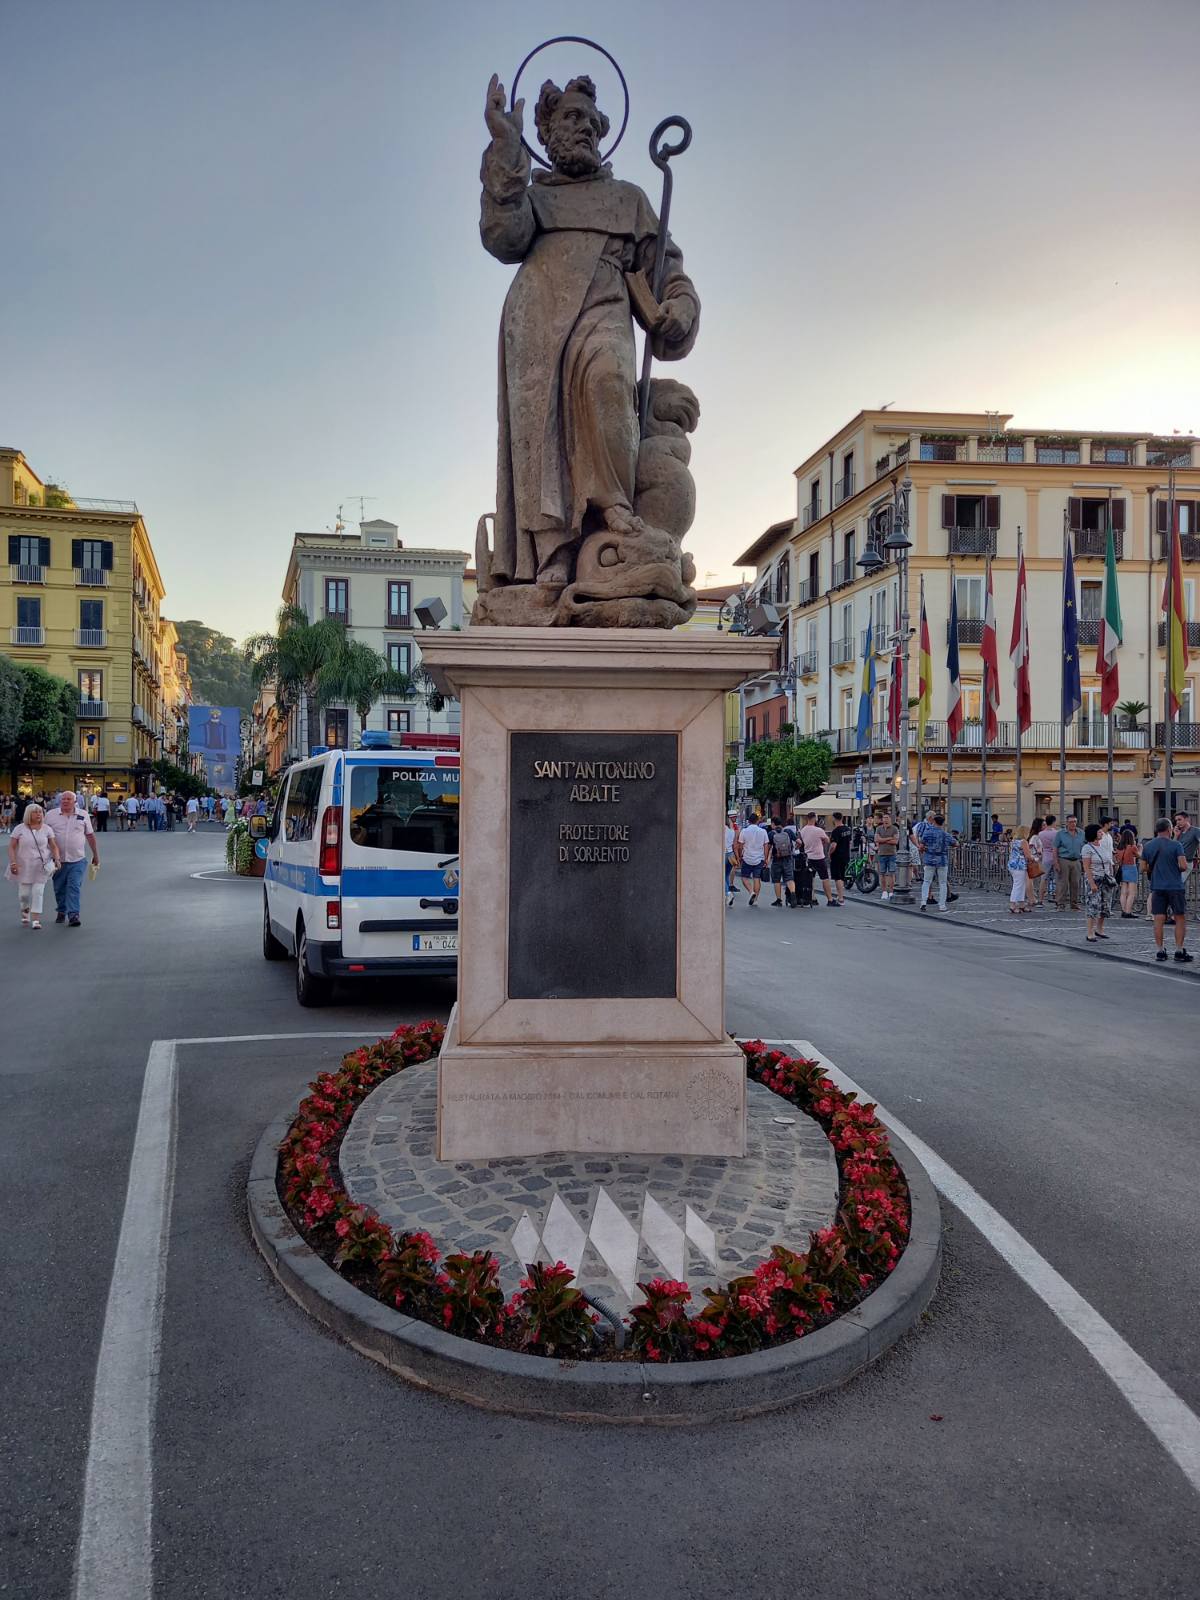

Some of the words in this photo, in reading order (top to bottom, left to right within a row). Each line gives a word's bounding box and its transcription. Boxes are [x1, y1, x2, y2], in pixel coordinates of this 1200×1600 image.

[392, 771, 437, 782] POLIZIA
[534, 761, 655, 779] SANT'ANTONINO
[570, 784, 620, 802] ABATE
[559, 824, 629, 841] PROTETTORE
[559, 847, 569, 862] DI
[573, 846, 630, 862] SORRENTO
